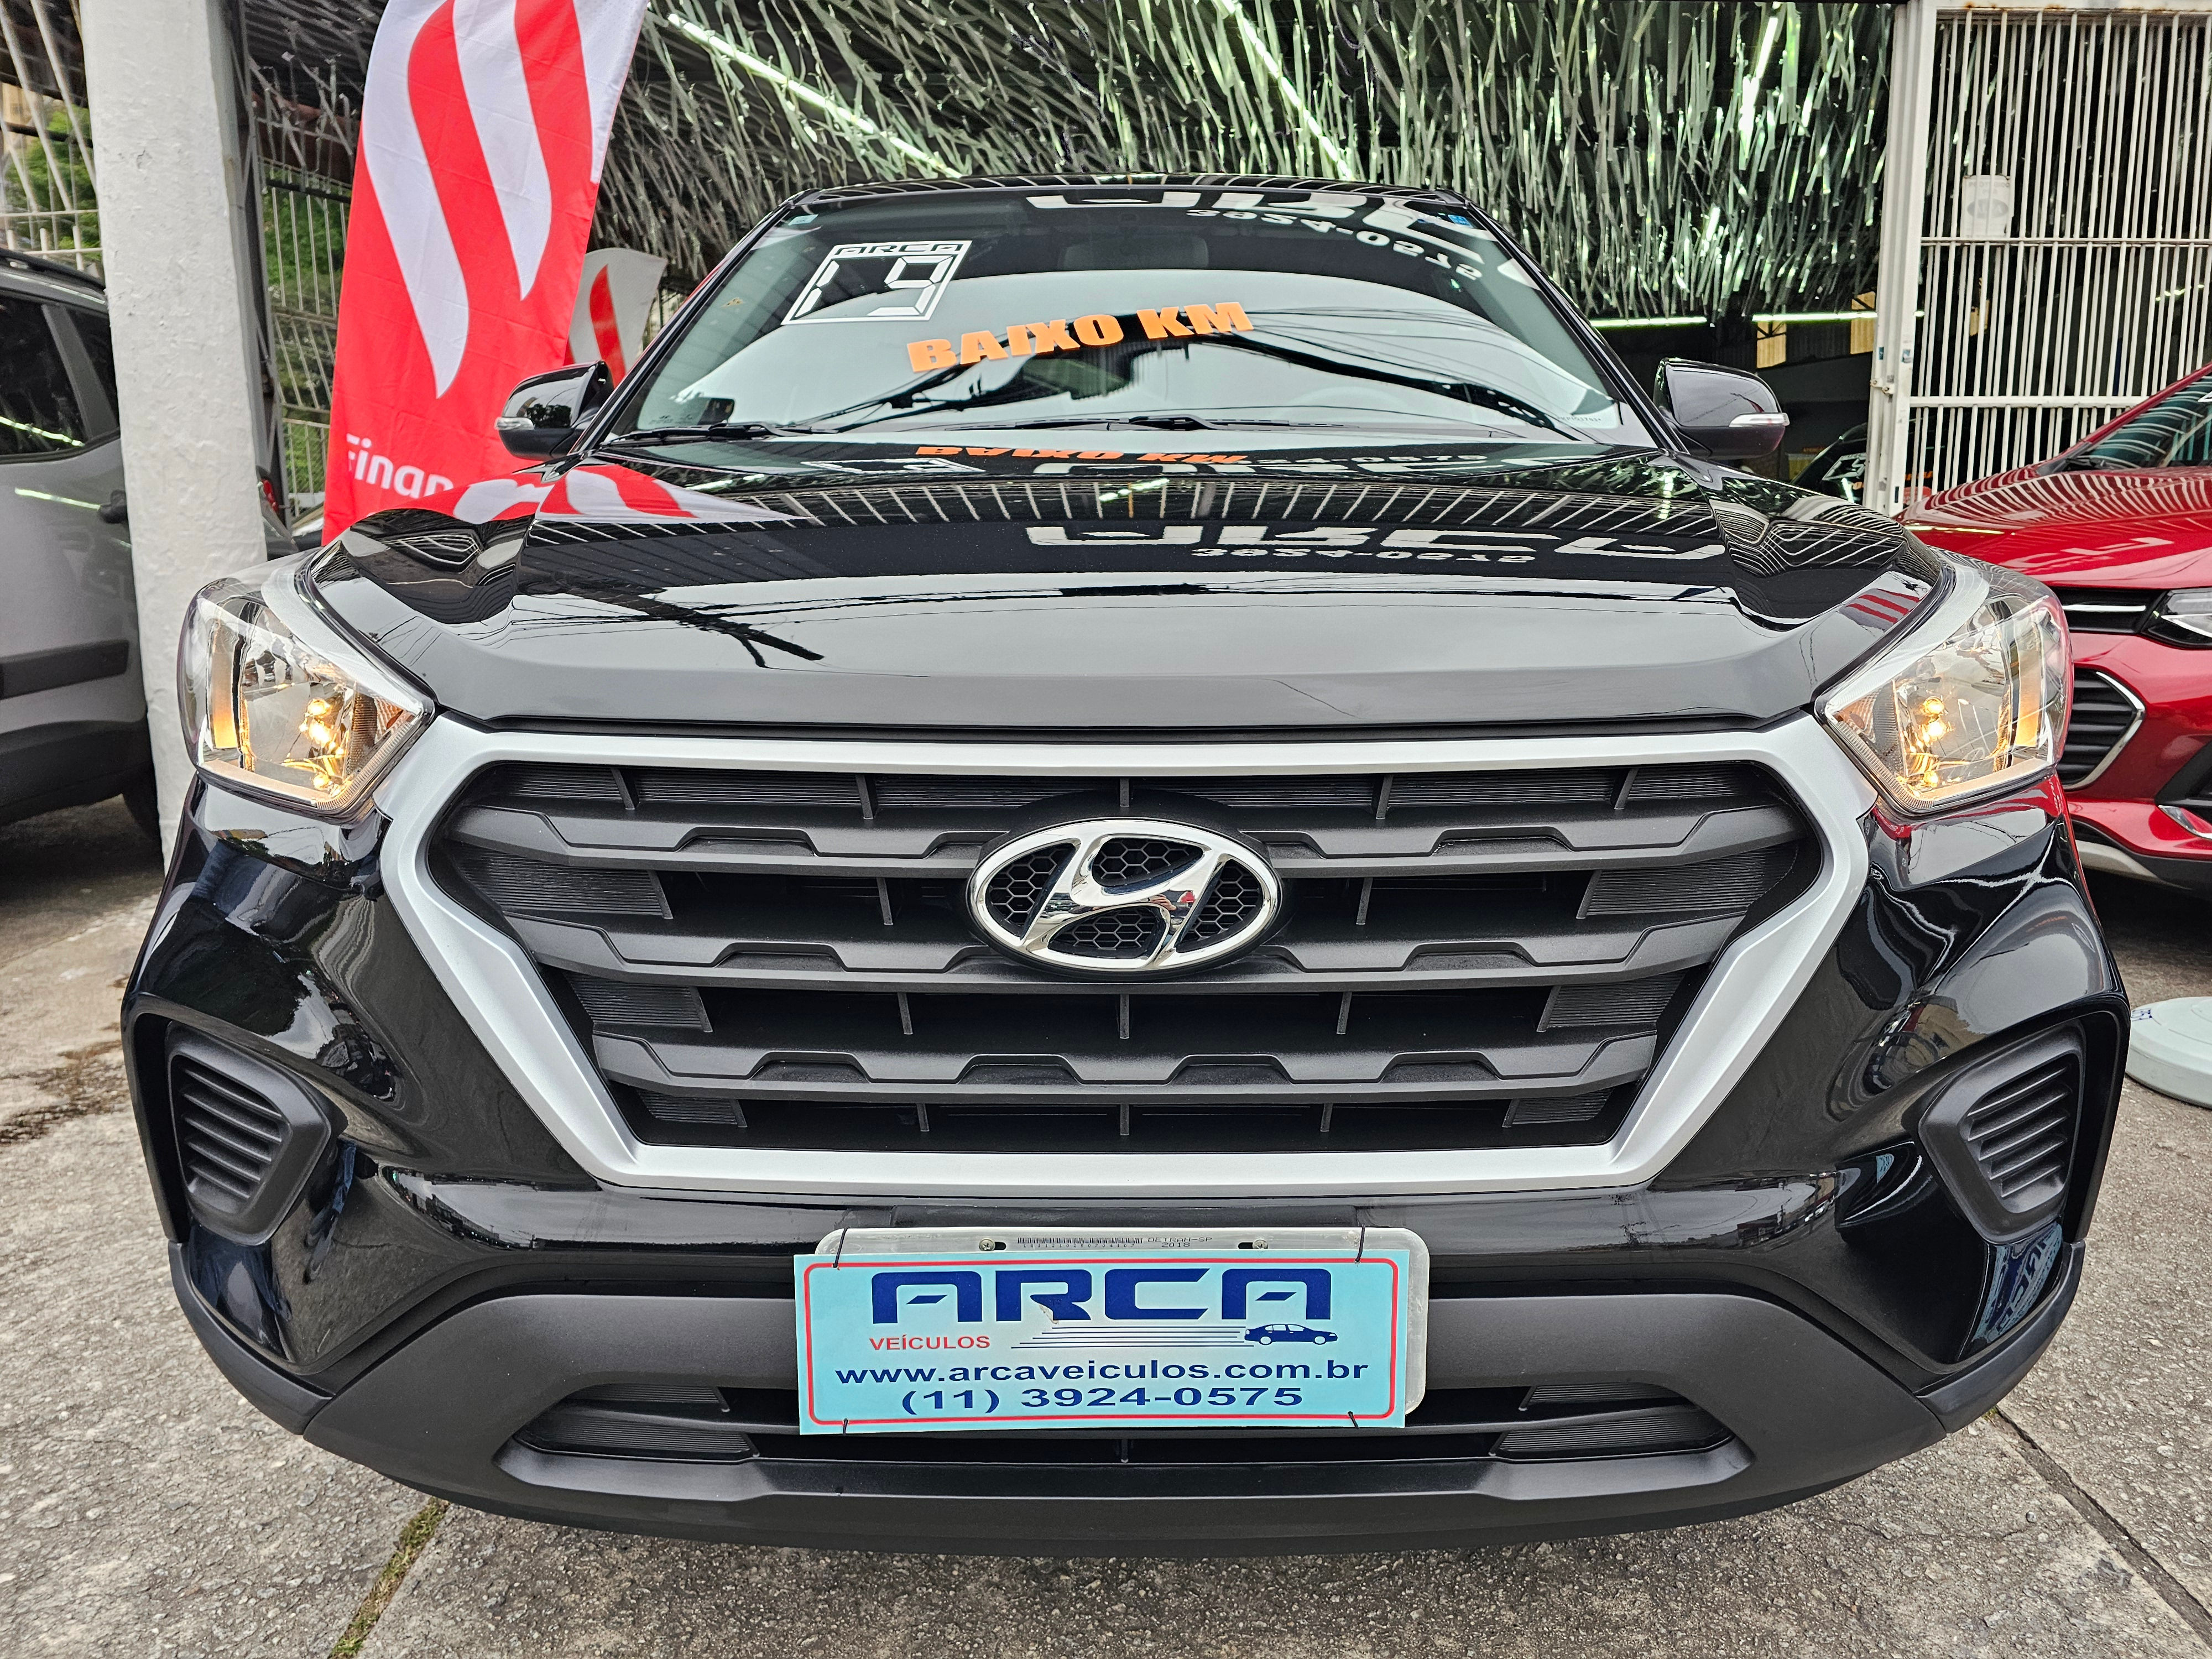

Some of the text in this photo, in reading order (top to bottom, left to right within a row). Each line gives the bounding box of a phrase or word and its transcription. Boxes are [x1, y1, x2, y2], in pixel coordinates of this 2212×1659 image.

[834, 244, 964, 255] ARCA
[794, 255, 954, 317] 19
[907, 302, 1254, 372] BAIXO KM
[871, 1267, 1332, 1324] ARCA
[869, 1334, 990, 1351] VEÍCULOS
[835, 1359, 1369, 1385] www.arcaveiculos.com.br
[902, 1387, 1303, 1413] (11) 3924-0575
